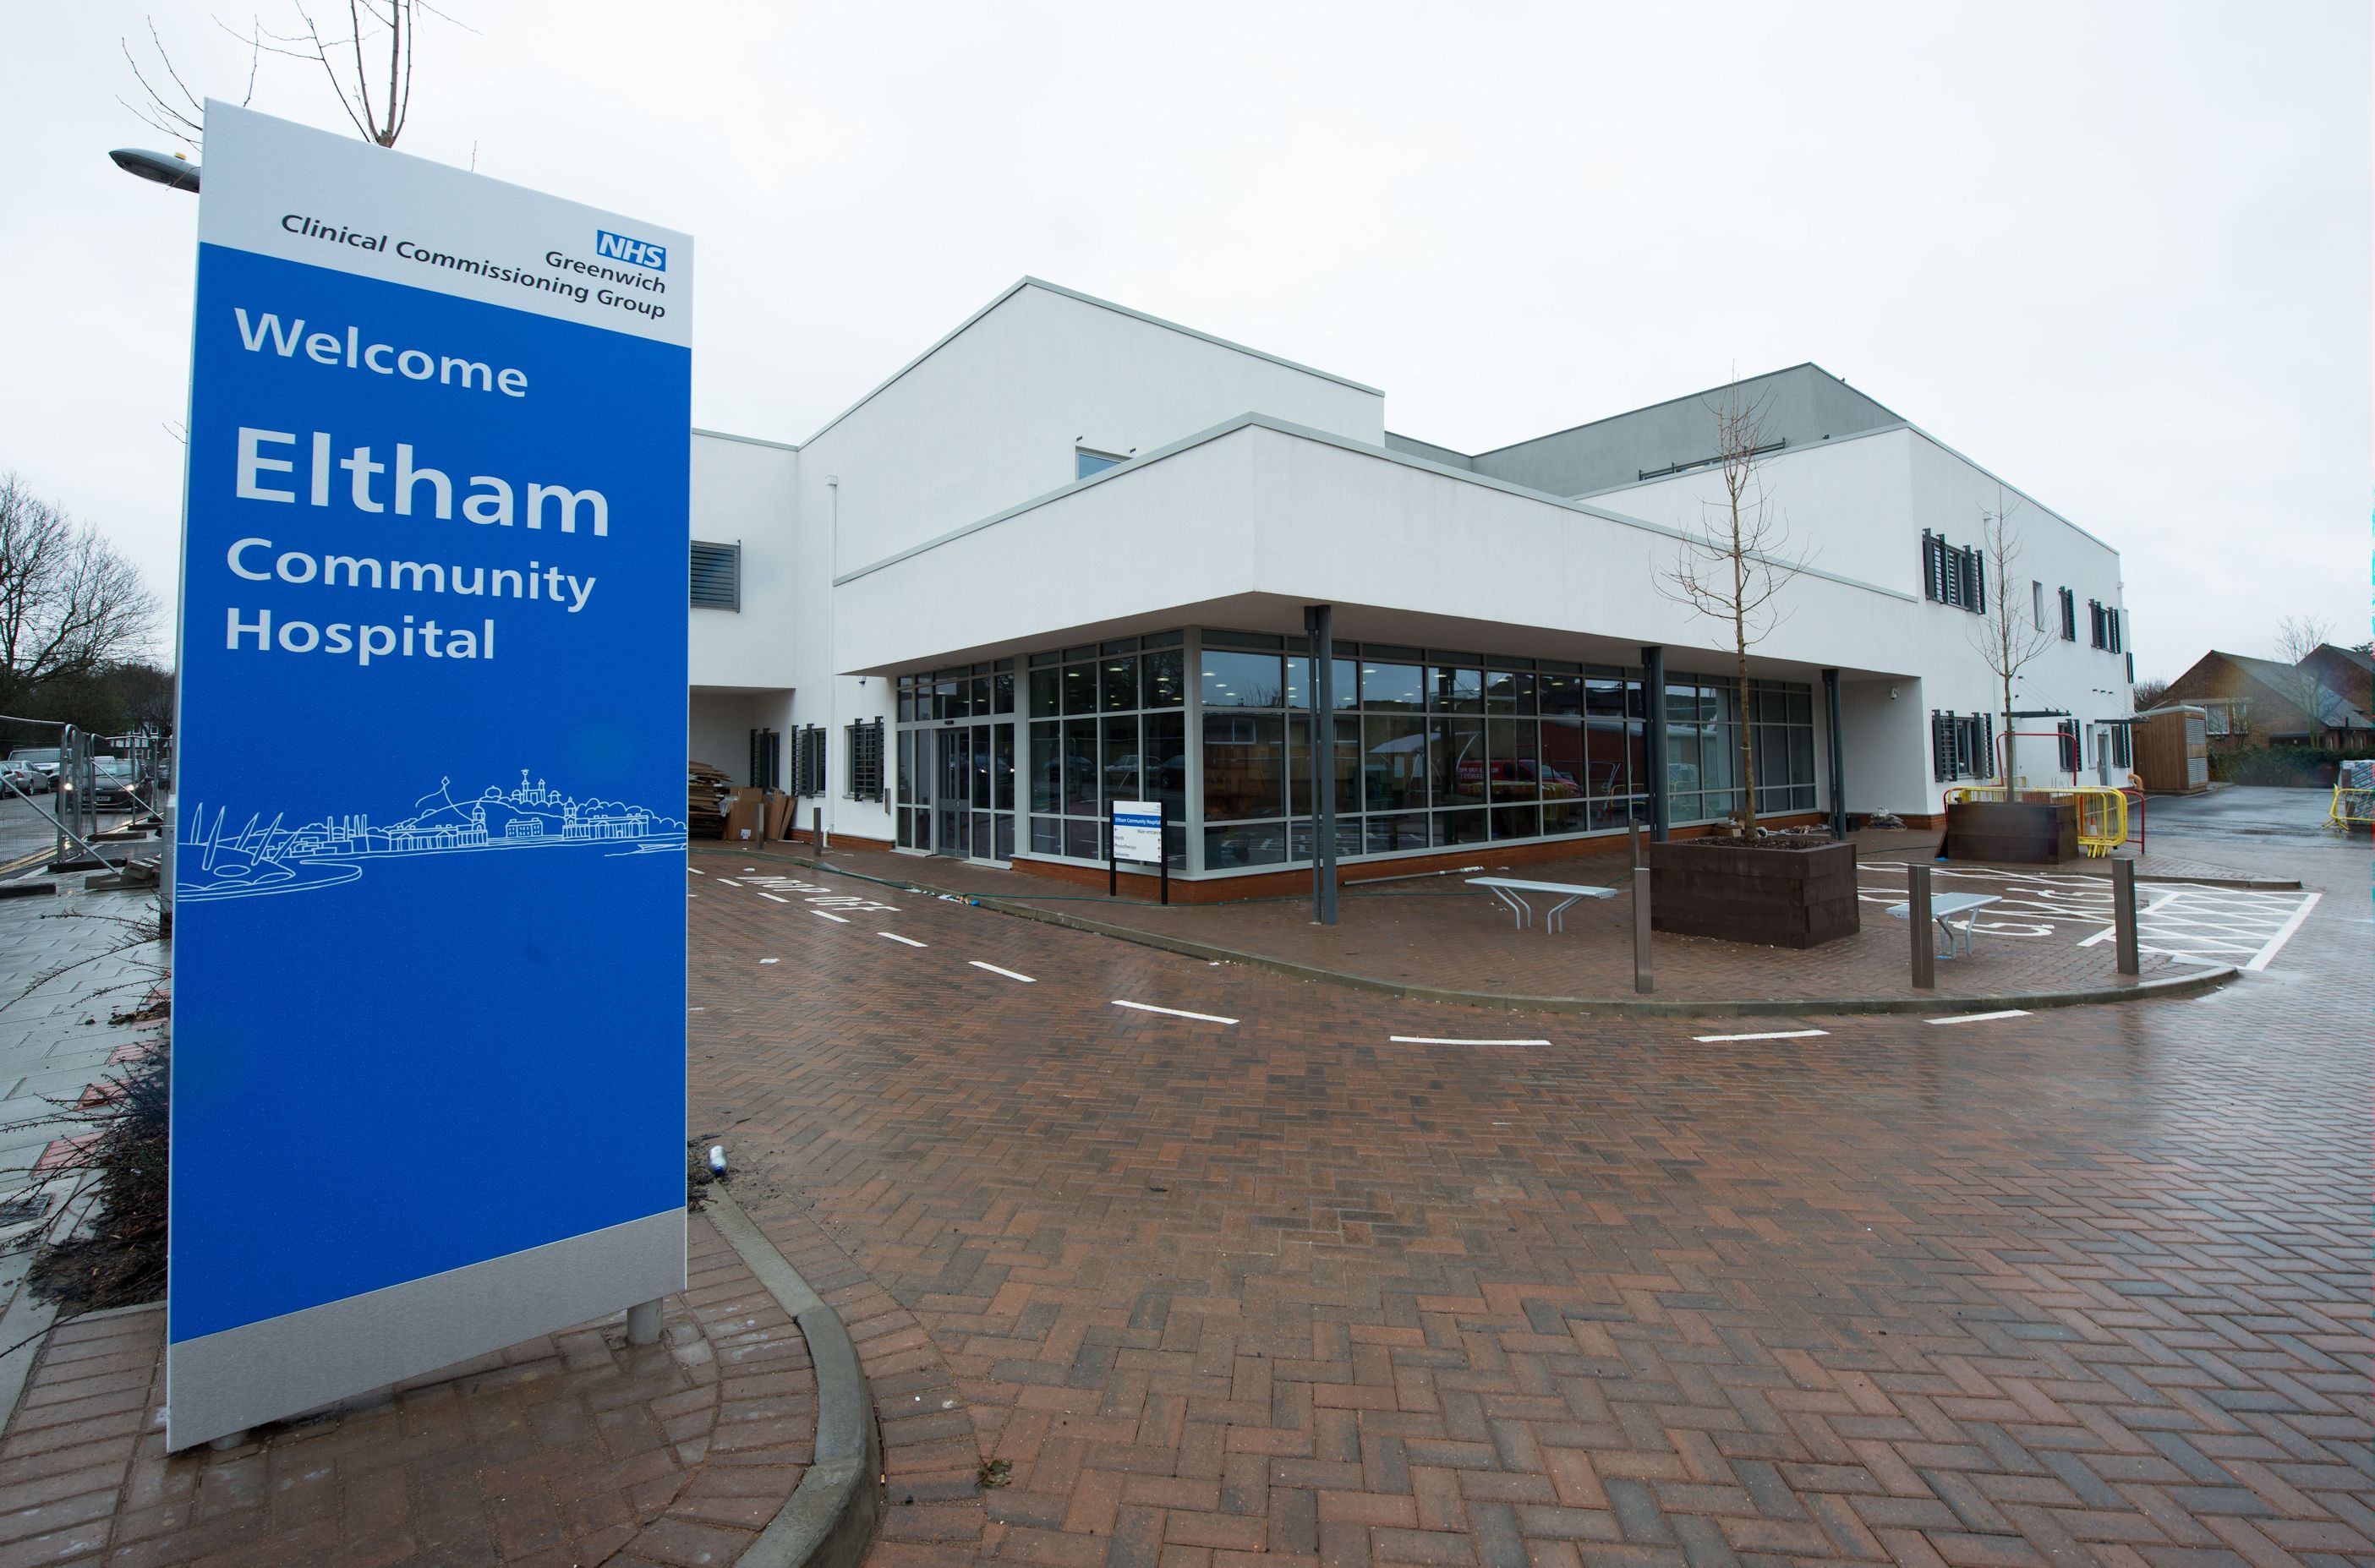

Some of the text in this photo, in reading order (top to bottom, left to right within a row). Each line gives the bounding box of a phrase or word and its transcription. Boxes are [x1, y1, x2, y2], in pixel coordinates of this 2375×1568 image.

[282, 215, 665, 320] Clinical Commissioning Group
[545, 251, 665, 294] Greenwich
[599, 233, 664, 268] NHS
[234, 307, 528, 397] Welcome
[236, 426, 608, 537] Eltham
[227, 538, 596, 613] Community
[227, 607, 494, 666] Hospital
[736, 876, 902, 911] DROP OFF
